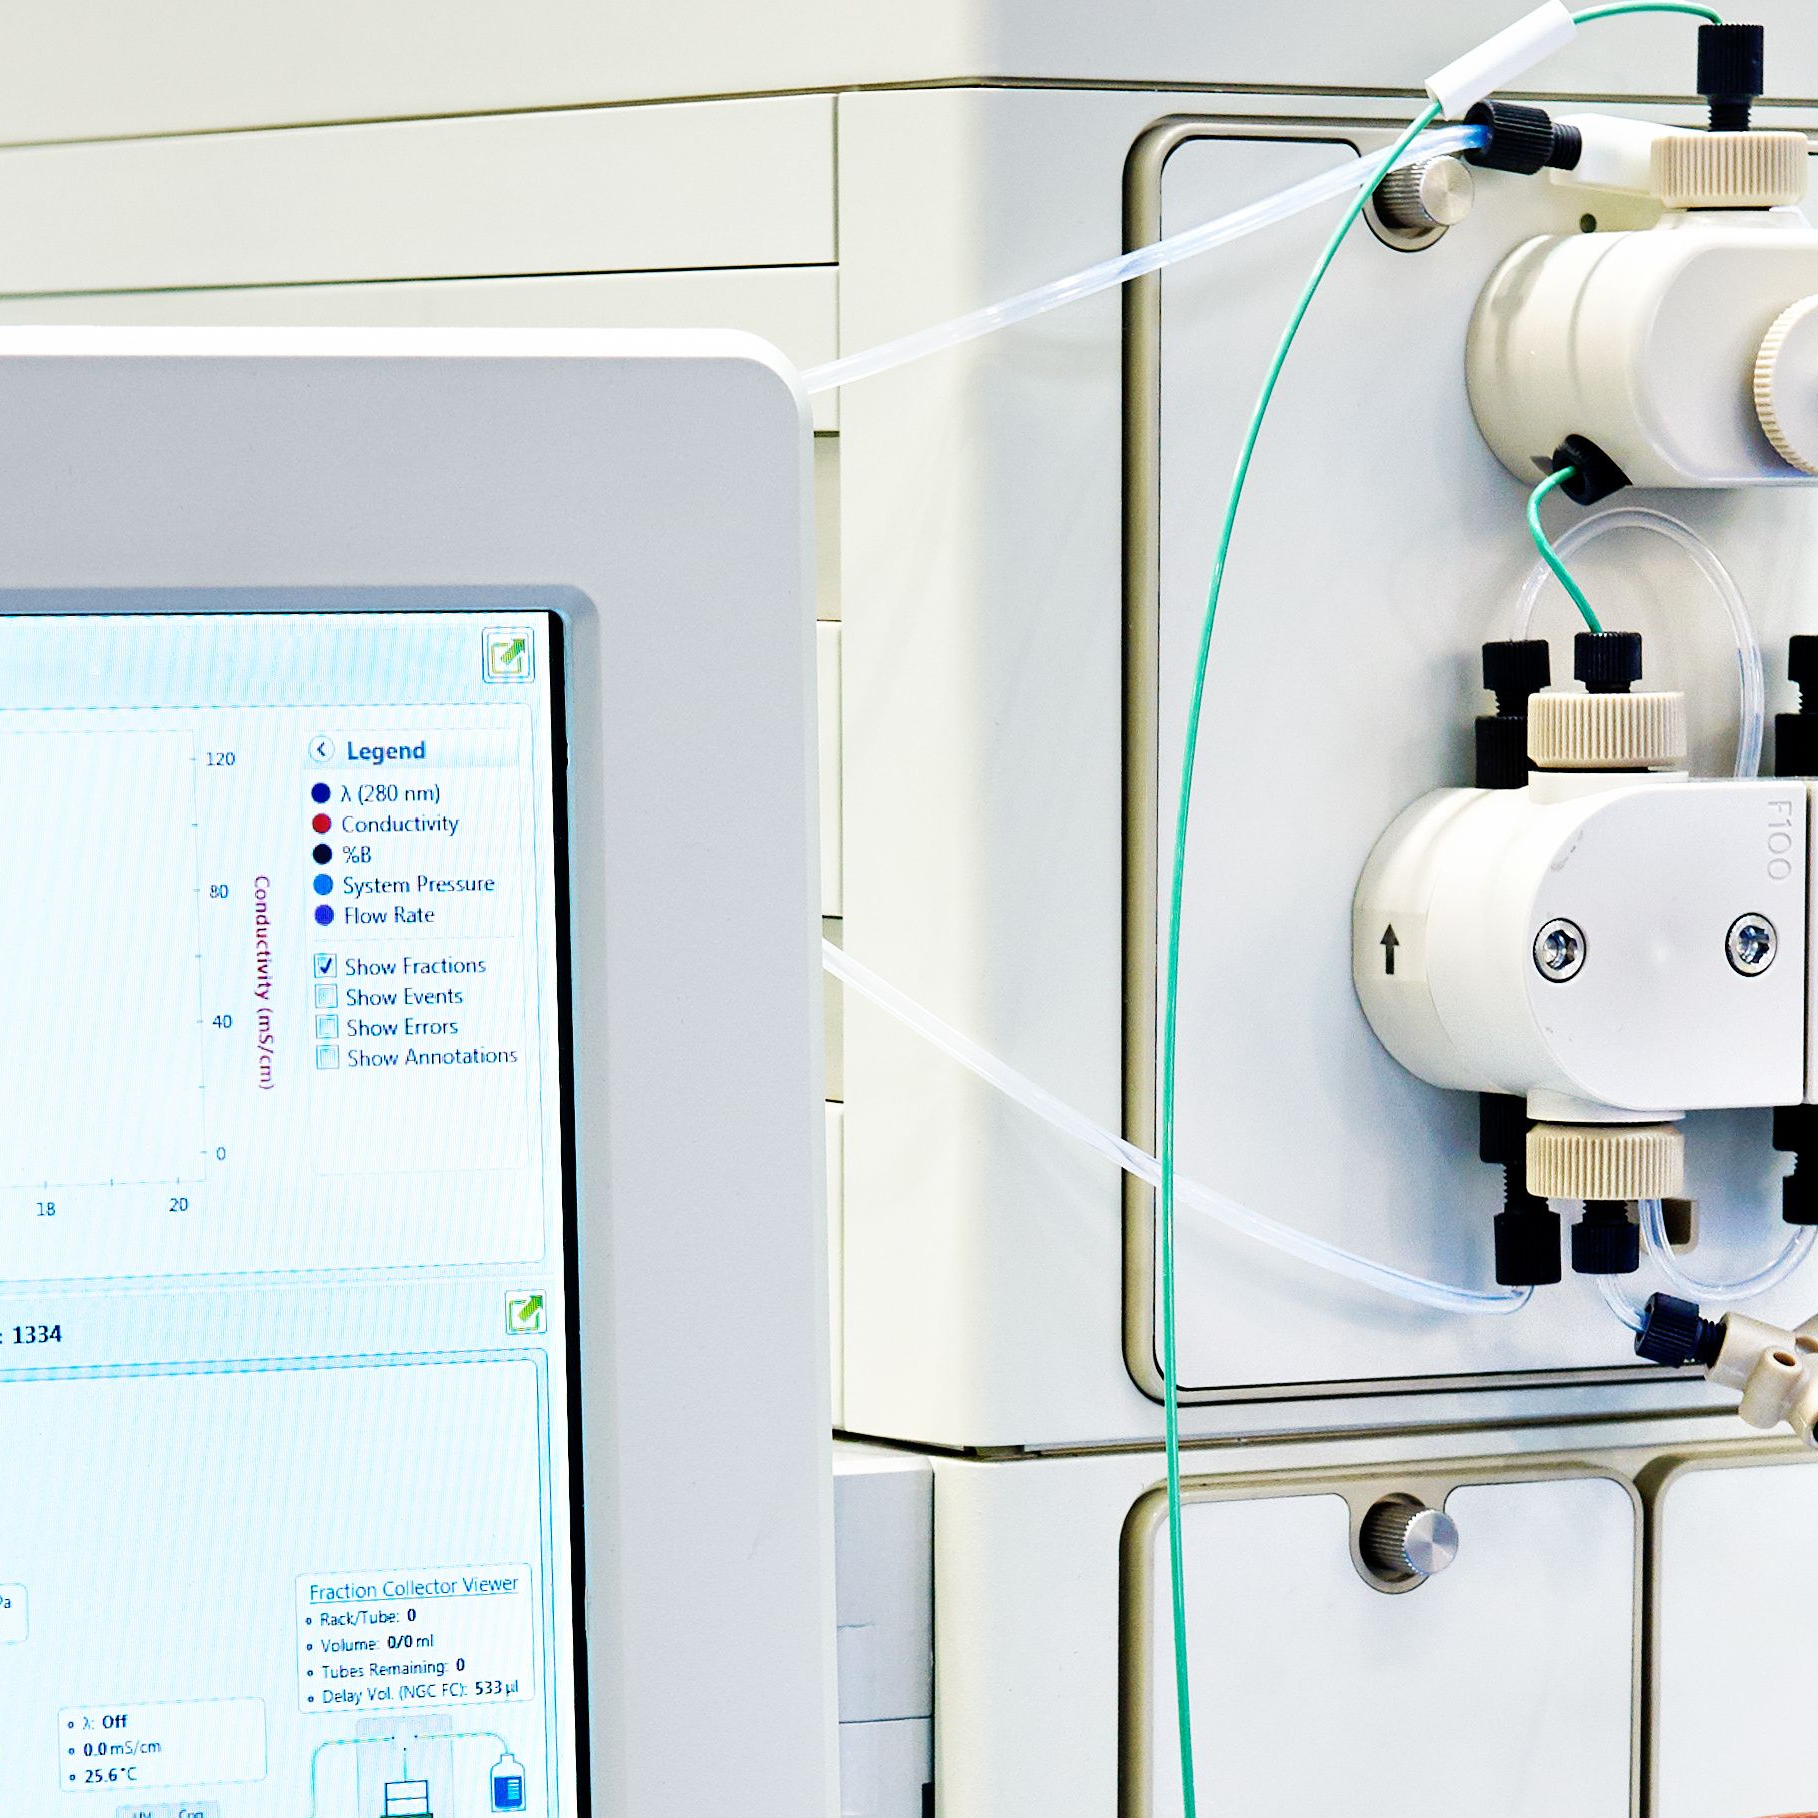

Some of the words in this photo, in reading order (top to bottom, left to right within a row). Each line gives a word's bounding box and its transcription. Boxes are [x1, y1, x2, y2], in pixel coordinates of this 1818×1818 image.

[206, 751, 235, 766] 120
[347, 740, 426, 763] Legend
[357, 783, 398, 804] (280
[404, 783, 441, 804] nm)
[342, 814, 460, 837] Conductivity
[1766, 800, 1792, 880] F100
[342, 846, 372, 864] %B
[209, 884, 229, 899] 80
[343, 876, 410, 898] System
[416, 875, 496, 893] Pressure
[344, 906, 388, 925] Flow
[394, 906, 436, 924] Rate
[254, 875, 273, 1001] Conductivity
[345, 957, 397, 976] Show
[403, 956, 487, 976] Fractions
[346, 989, 398, 1007] Show
[404, 988, 464, 1005] Events
[212, 1014, 233, 1030] 40
[346, 1019, 399, 1038] Show
[404, 1018, 459, 1036] Errors
[256, 1008, 275, 1090] (mS/cm)
[347, 1049, 400, 1068] Show
[404, 1047, 519, 1066] Annotations
[216, 1147, 227, 1162] 0
[36, 1202, 56, 1217] 18
[168, 1197, 189, 1213] 20
[12, 1325, 63, 1346] 1334
[310, 1582, 377, 1601] Fraction
[382, 1579, 458, 1598] Collector
[462, 1576, 519, 1594] Viewer
[320, 1610, 400, 1627] Rack/Tube:
[407, 1608, 416, 1622] 0
[321, 1638, 379, 1653] Volume:
[387, 1634, 413, 1650] 0/0
[416, 1633, 434, 1648] ml
[322, 1663, 364, 1678] Tubes
[369, 1659, 448, 1678] Remaining:
[456, 1658, 465, 1671] 0
[322, 1689, 362, 1706] Delay
[367, 1686, 394, 1701] Vol.
[399, 1684, 437, 1702] (NGC
[101, 1714, 128, 1731] Off
[83, 1741, 107, 1757] 0.0
[109, 1739, 161, 1756] mS/cm
